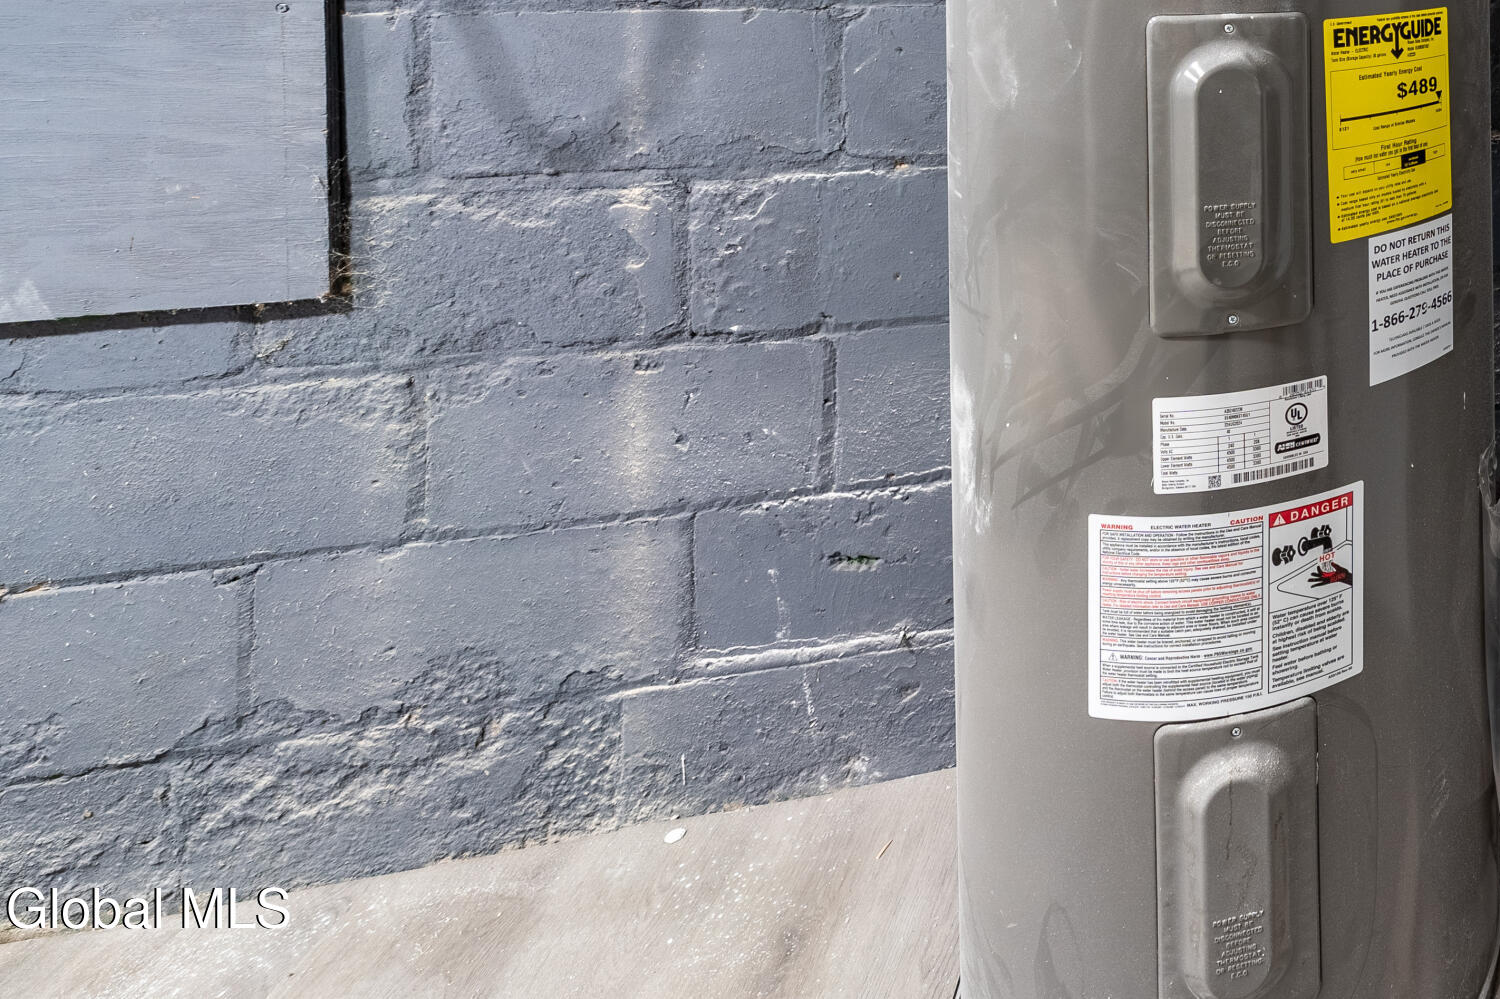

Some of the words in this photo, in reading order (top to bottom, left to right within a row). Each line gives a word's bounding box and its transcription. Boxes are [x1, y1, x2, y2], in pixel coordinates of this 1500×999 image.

[1333, 17, 1442, 49] ENERGYGUIDE
[1397, 77, 1437, 99] $489
[1374, 243, 1387, 254] DO
[1389, 238, 1406, 250] NOT
[1408, 229, 1435, 245] RETURN
[1437, 223, 1450, 236] THIS
[1371, 255, 1400, 269] WATER
[1402, 245, 1429, 261] HEATER
[1430, 242, 1439, 252] TO
[1440, 236, 1451, 249] THE
[1376, 267, 1401, 282] PLACE
[1403, 263, 1414, 274] OF
[1415, 250, 1449, 271] PURCHASE
[1371, 291, 1452, 332] 1-866-279-4566
[1291, 407, 1302, 420] UL
[1230, 516, 1263, 525] CAUTION
[1290, 496, 1349, 520] DANGER
[1320, 552, 1335, 562] HOT
